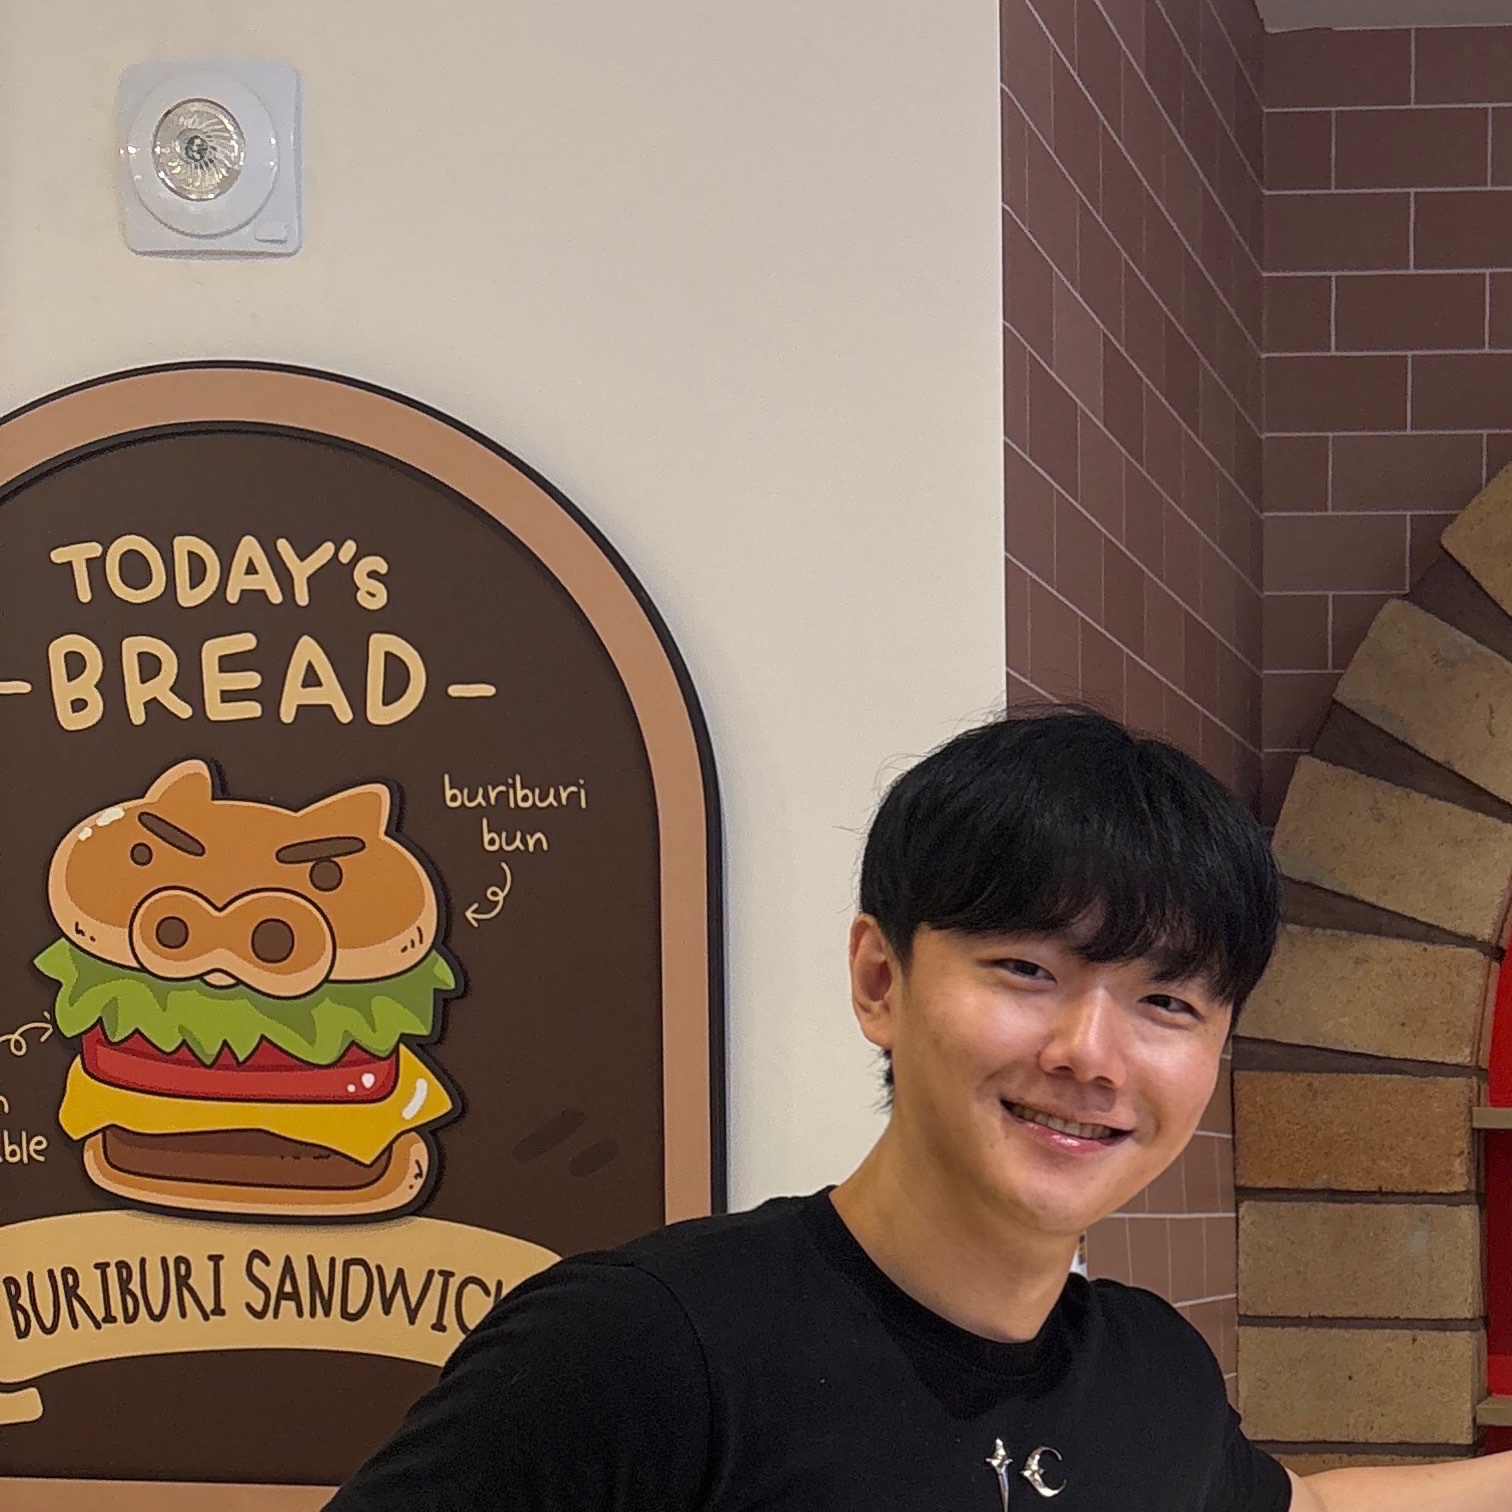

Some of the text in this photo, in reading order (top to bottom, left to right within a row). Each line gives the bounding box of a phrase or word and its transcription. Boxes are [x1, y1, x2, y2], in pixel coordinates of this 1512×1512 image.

[49, 534, 389, 611] TODAY's
[47, 632, 427, 732] BREAD
[443, 773, 587, 809] buriburi
[481, 816, 548, 853] bun
[0, 1129, 48, 1165] ble
[2, 1248, 504, 1340] BURIBURI SANDWIC
